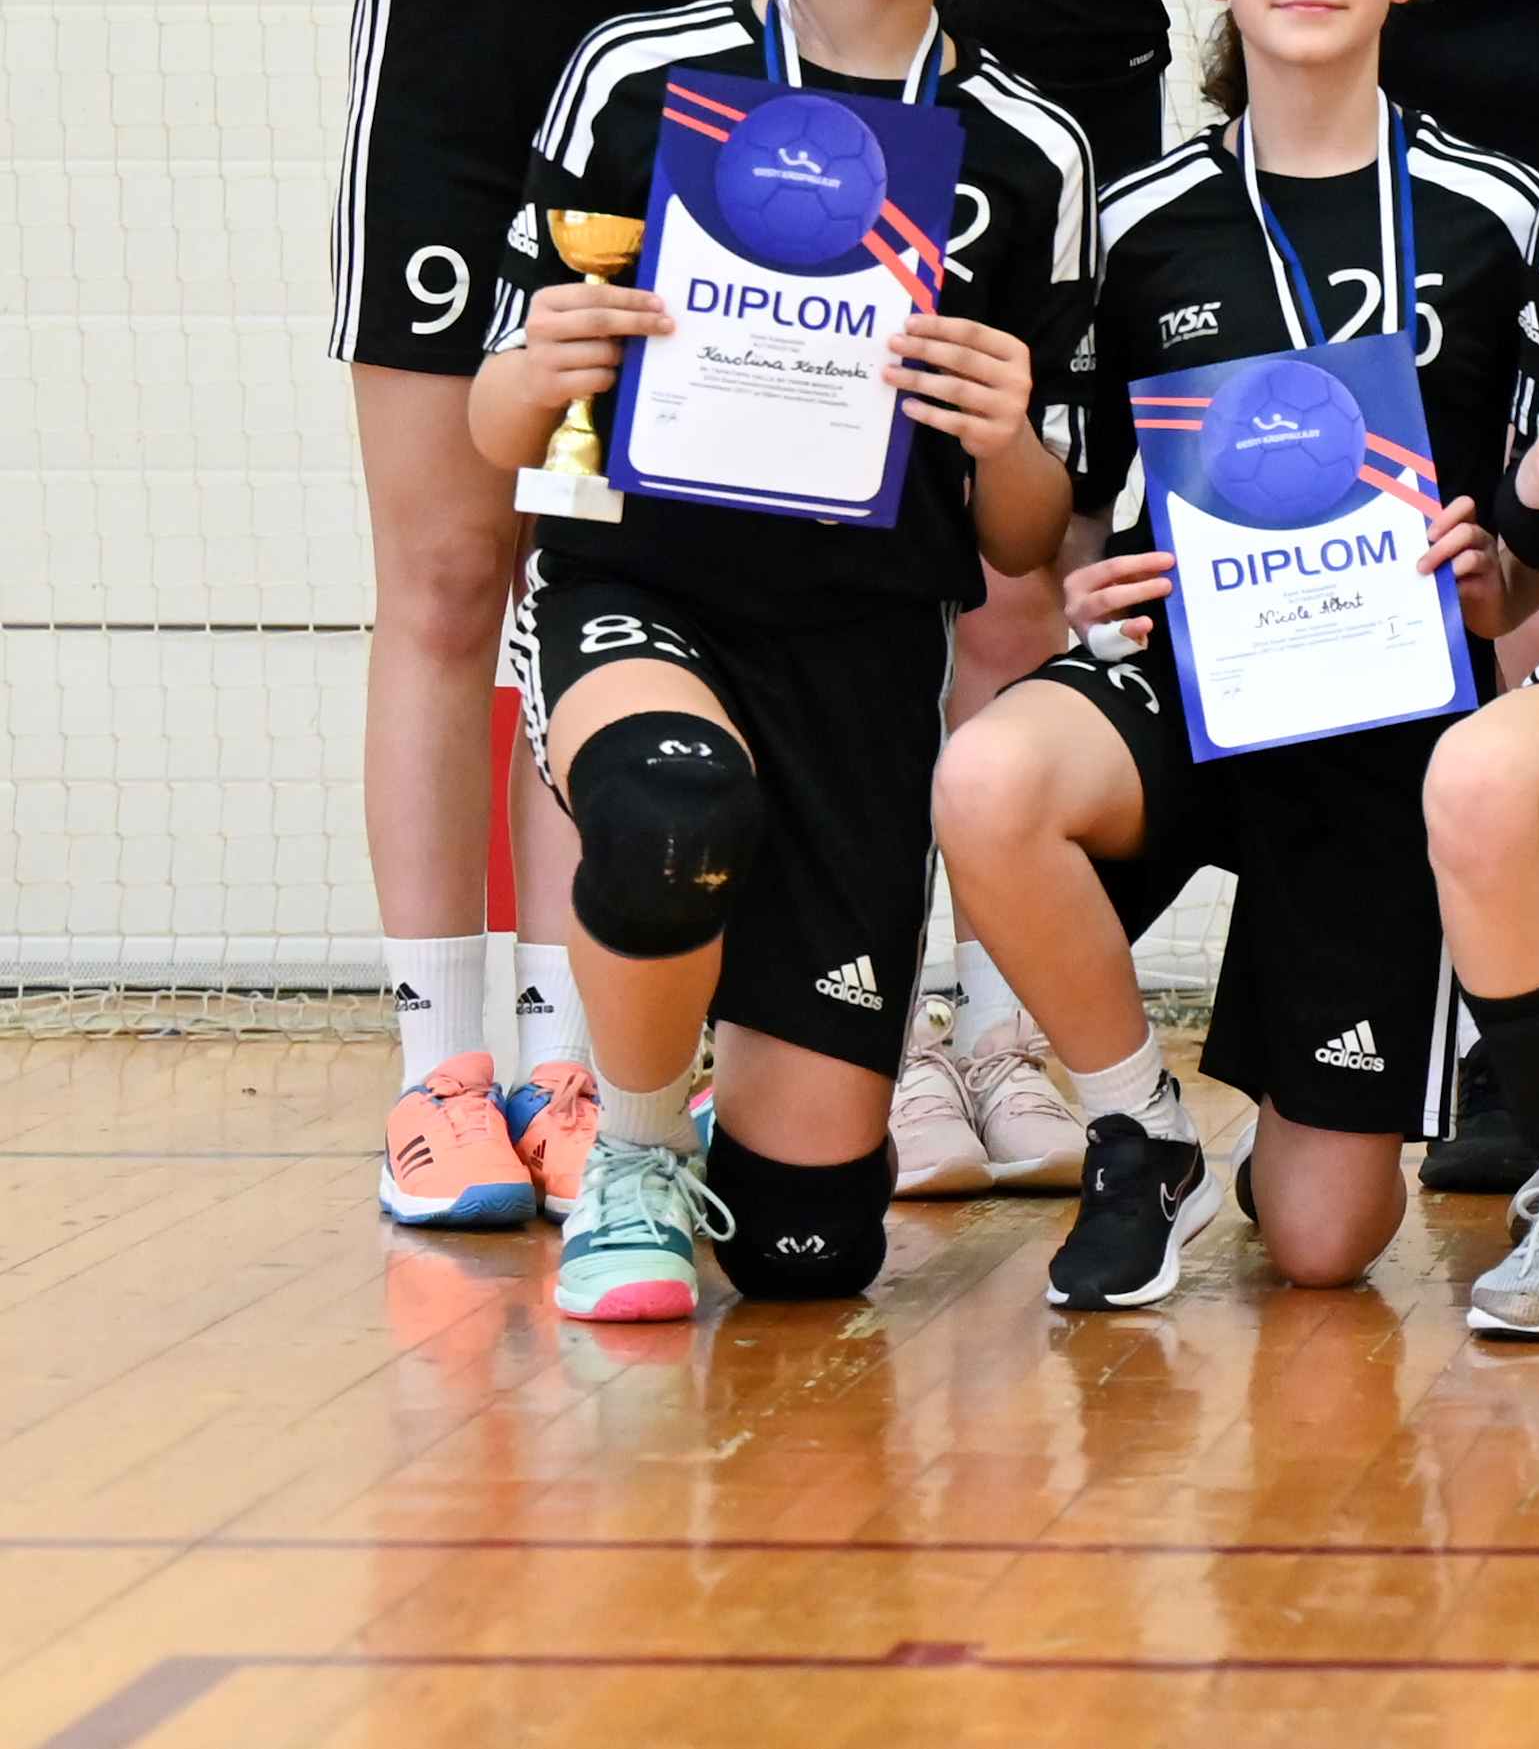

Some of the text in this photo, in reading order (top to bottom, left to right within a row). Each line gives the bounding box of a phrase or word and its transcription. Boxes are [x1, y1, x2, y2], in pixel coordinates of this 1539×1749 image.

[406, 245, 470, 335] 9
[686, 278, 876, 338] DIPLOM
[1158, 301, 1222, 342] TVSK
[1212, 530, 1397, 592] DIPLOM
[1255, 605, 1312, 628] Nicole
[816, 978, 883, 1010] adidas
[1314, 1048, 1385, 1072] adidas
